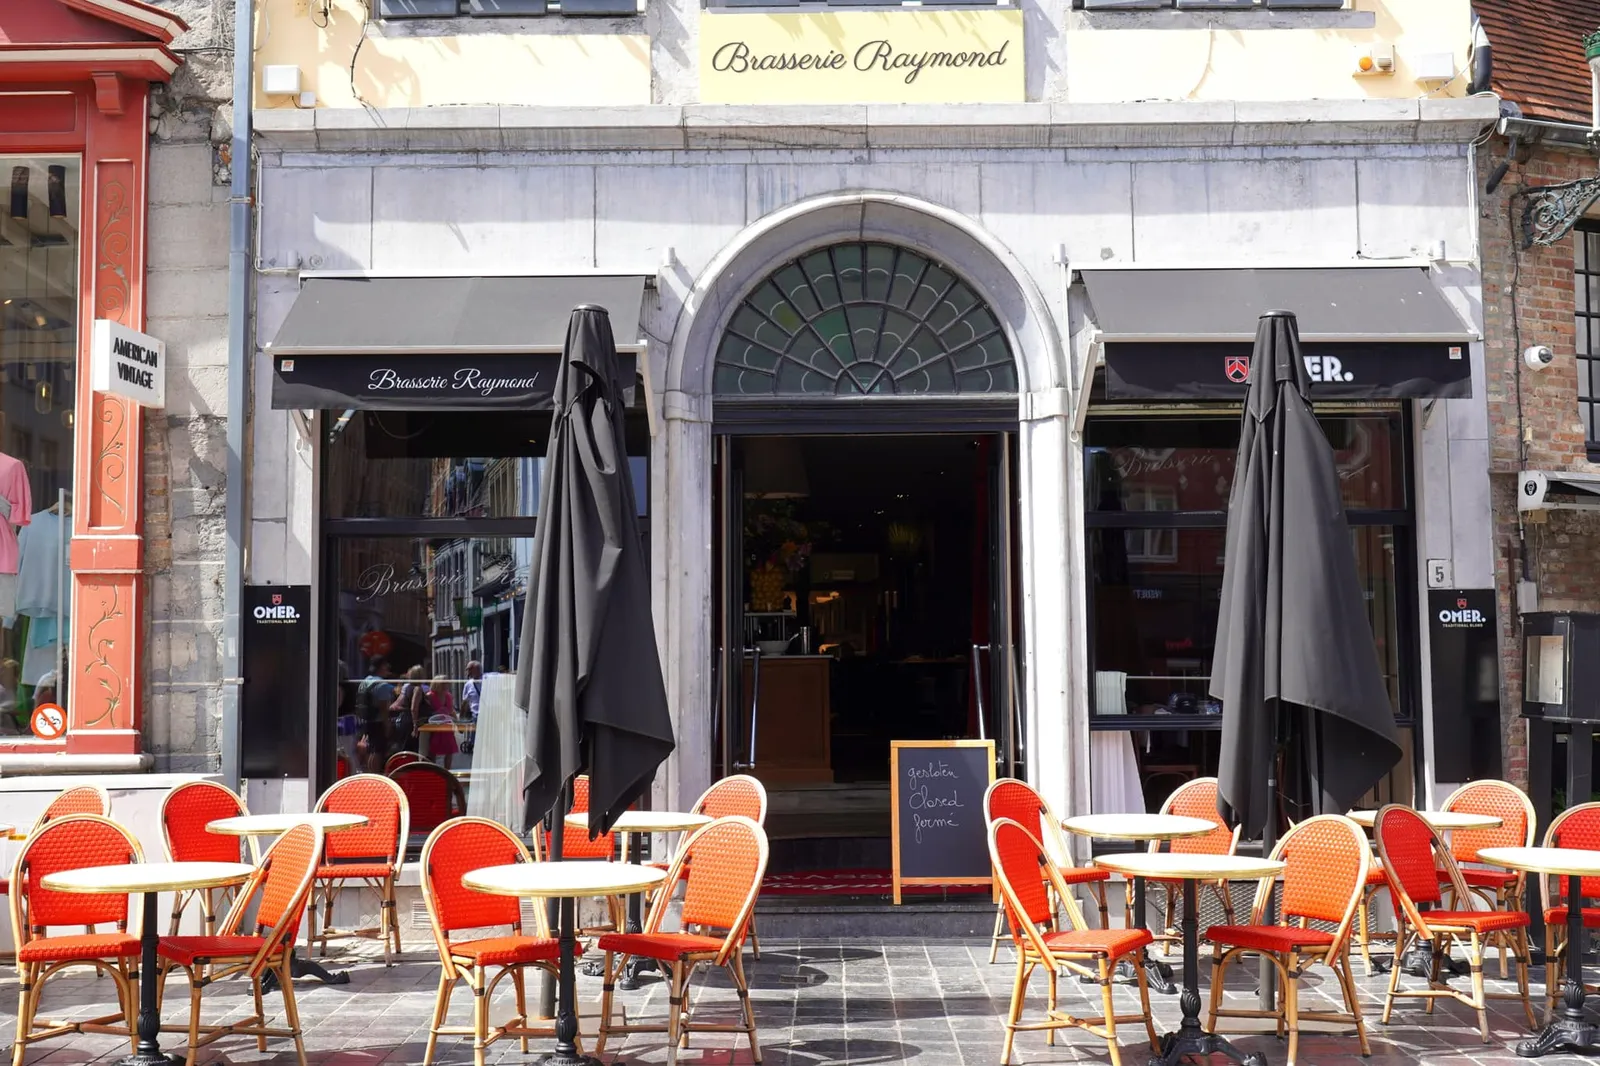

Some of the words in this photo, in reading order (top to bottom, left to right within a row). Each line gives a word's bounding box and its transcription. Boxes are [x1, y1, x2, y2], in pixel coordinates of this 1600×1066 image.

[712, 41, 847, 73] Brasserie
[853, 40, 1010, 84] Raymond
[113, 337, 158, 368] AMERICAN
[117, 361, 154, 390] VINTAGE
[367, 368, 449, 391] Brasserie
[452, 368, 539, 396] Raymond
[1302, 356, 1354, 381] ER.
[1435, 566, 1445, 583] 5
[253, 605, 301, 619] OMER.
[1438, 609, 1487, 623] OMER.
[907, 760, 959, 791] gesloten
[908, 784, 964, 810] Closed
[913, 813, 960, 844] fermé
